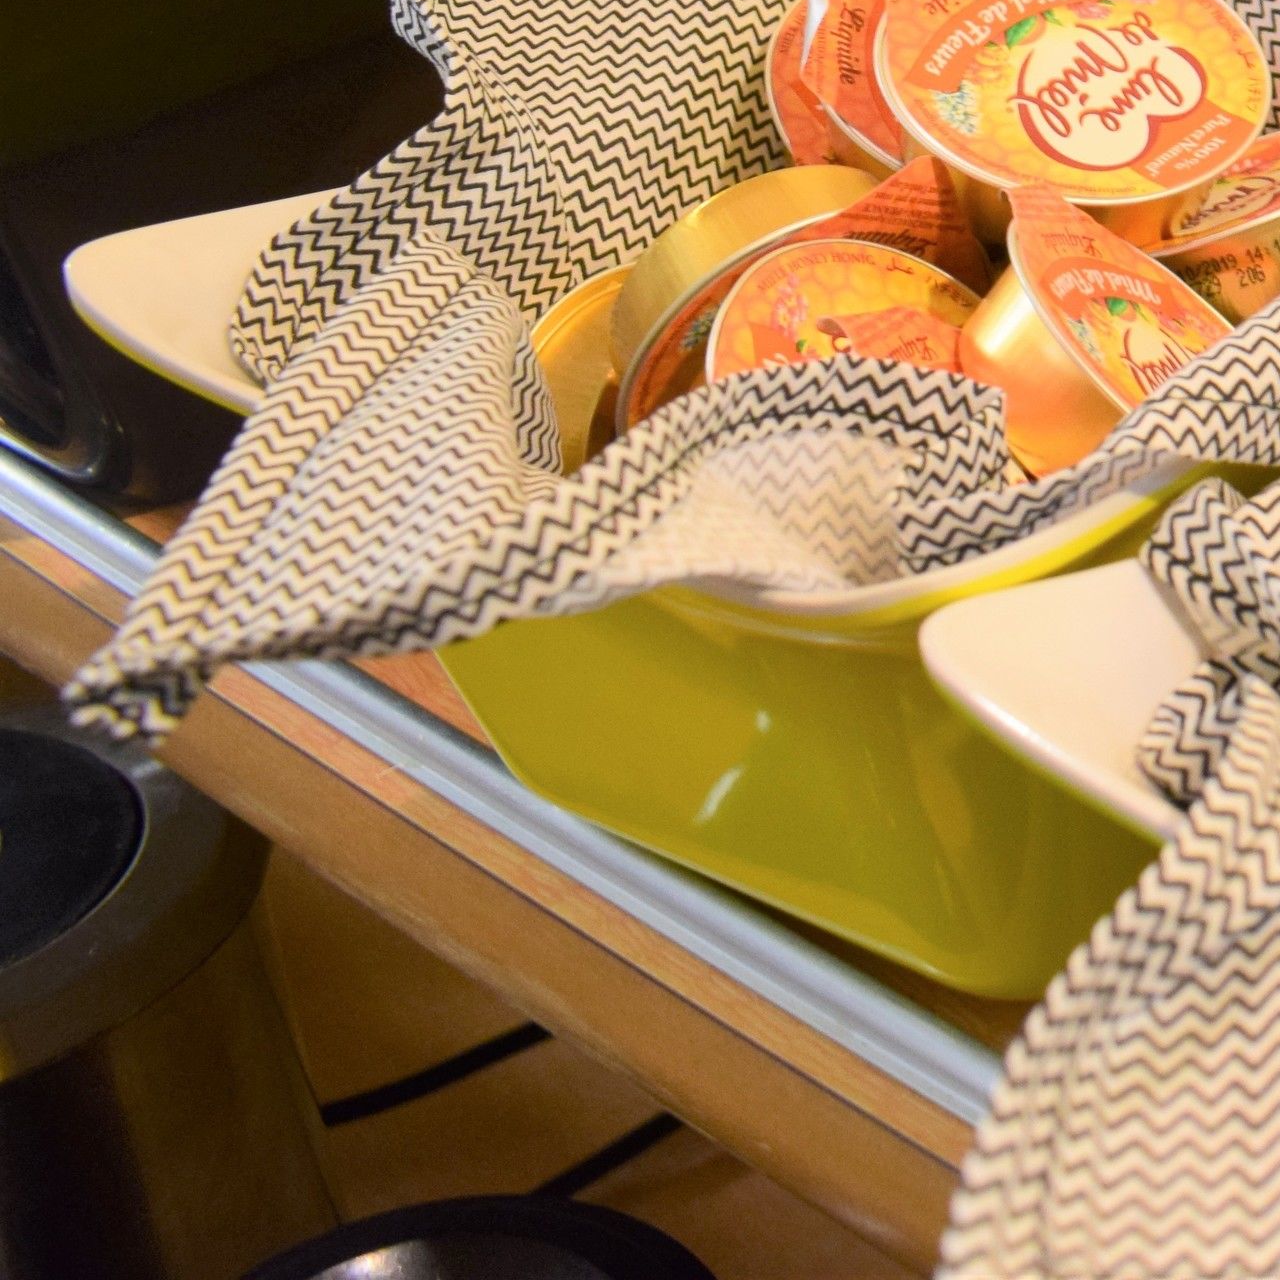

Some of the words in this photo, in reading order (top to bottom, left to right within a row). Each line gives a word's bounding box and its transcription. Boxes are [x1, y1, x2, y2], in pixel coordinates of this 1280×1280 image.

[977, 1, 1009, 23] de
[1106, 10, 1159, 46] de
[923, 19, 992, 77] Fleurs
[1006, 23, 1129, 138] Miel
[1203, 113, 1232, 135] Pur
[1173, 136, 1228, 171] 100%
